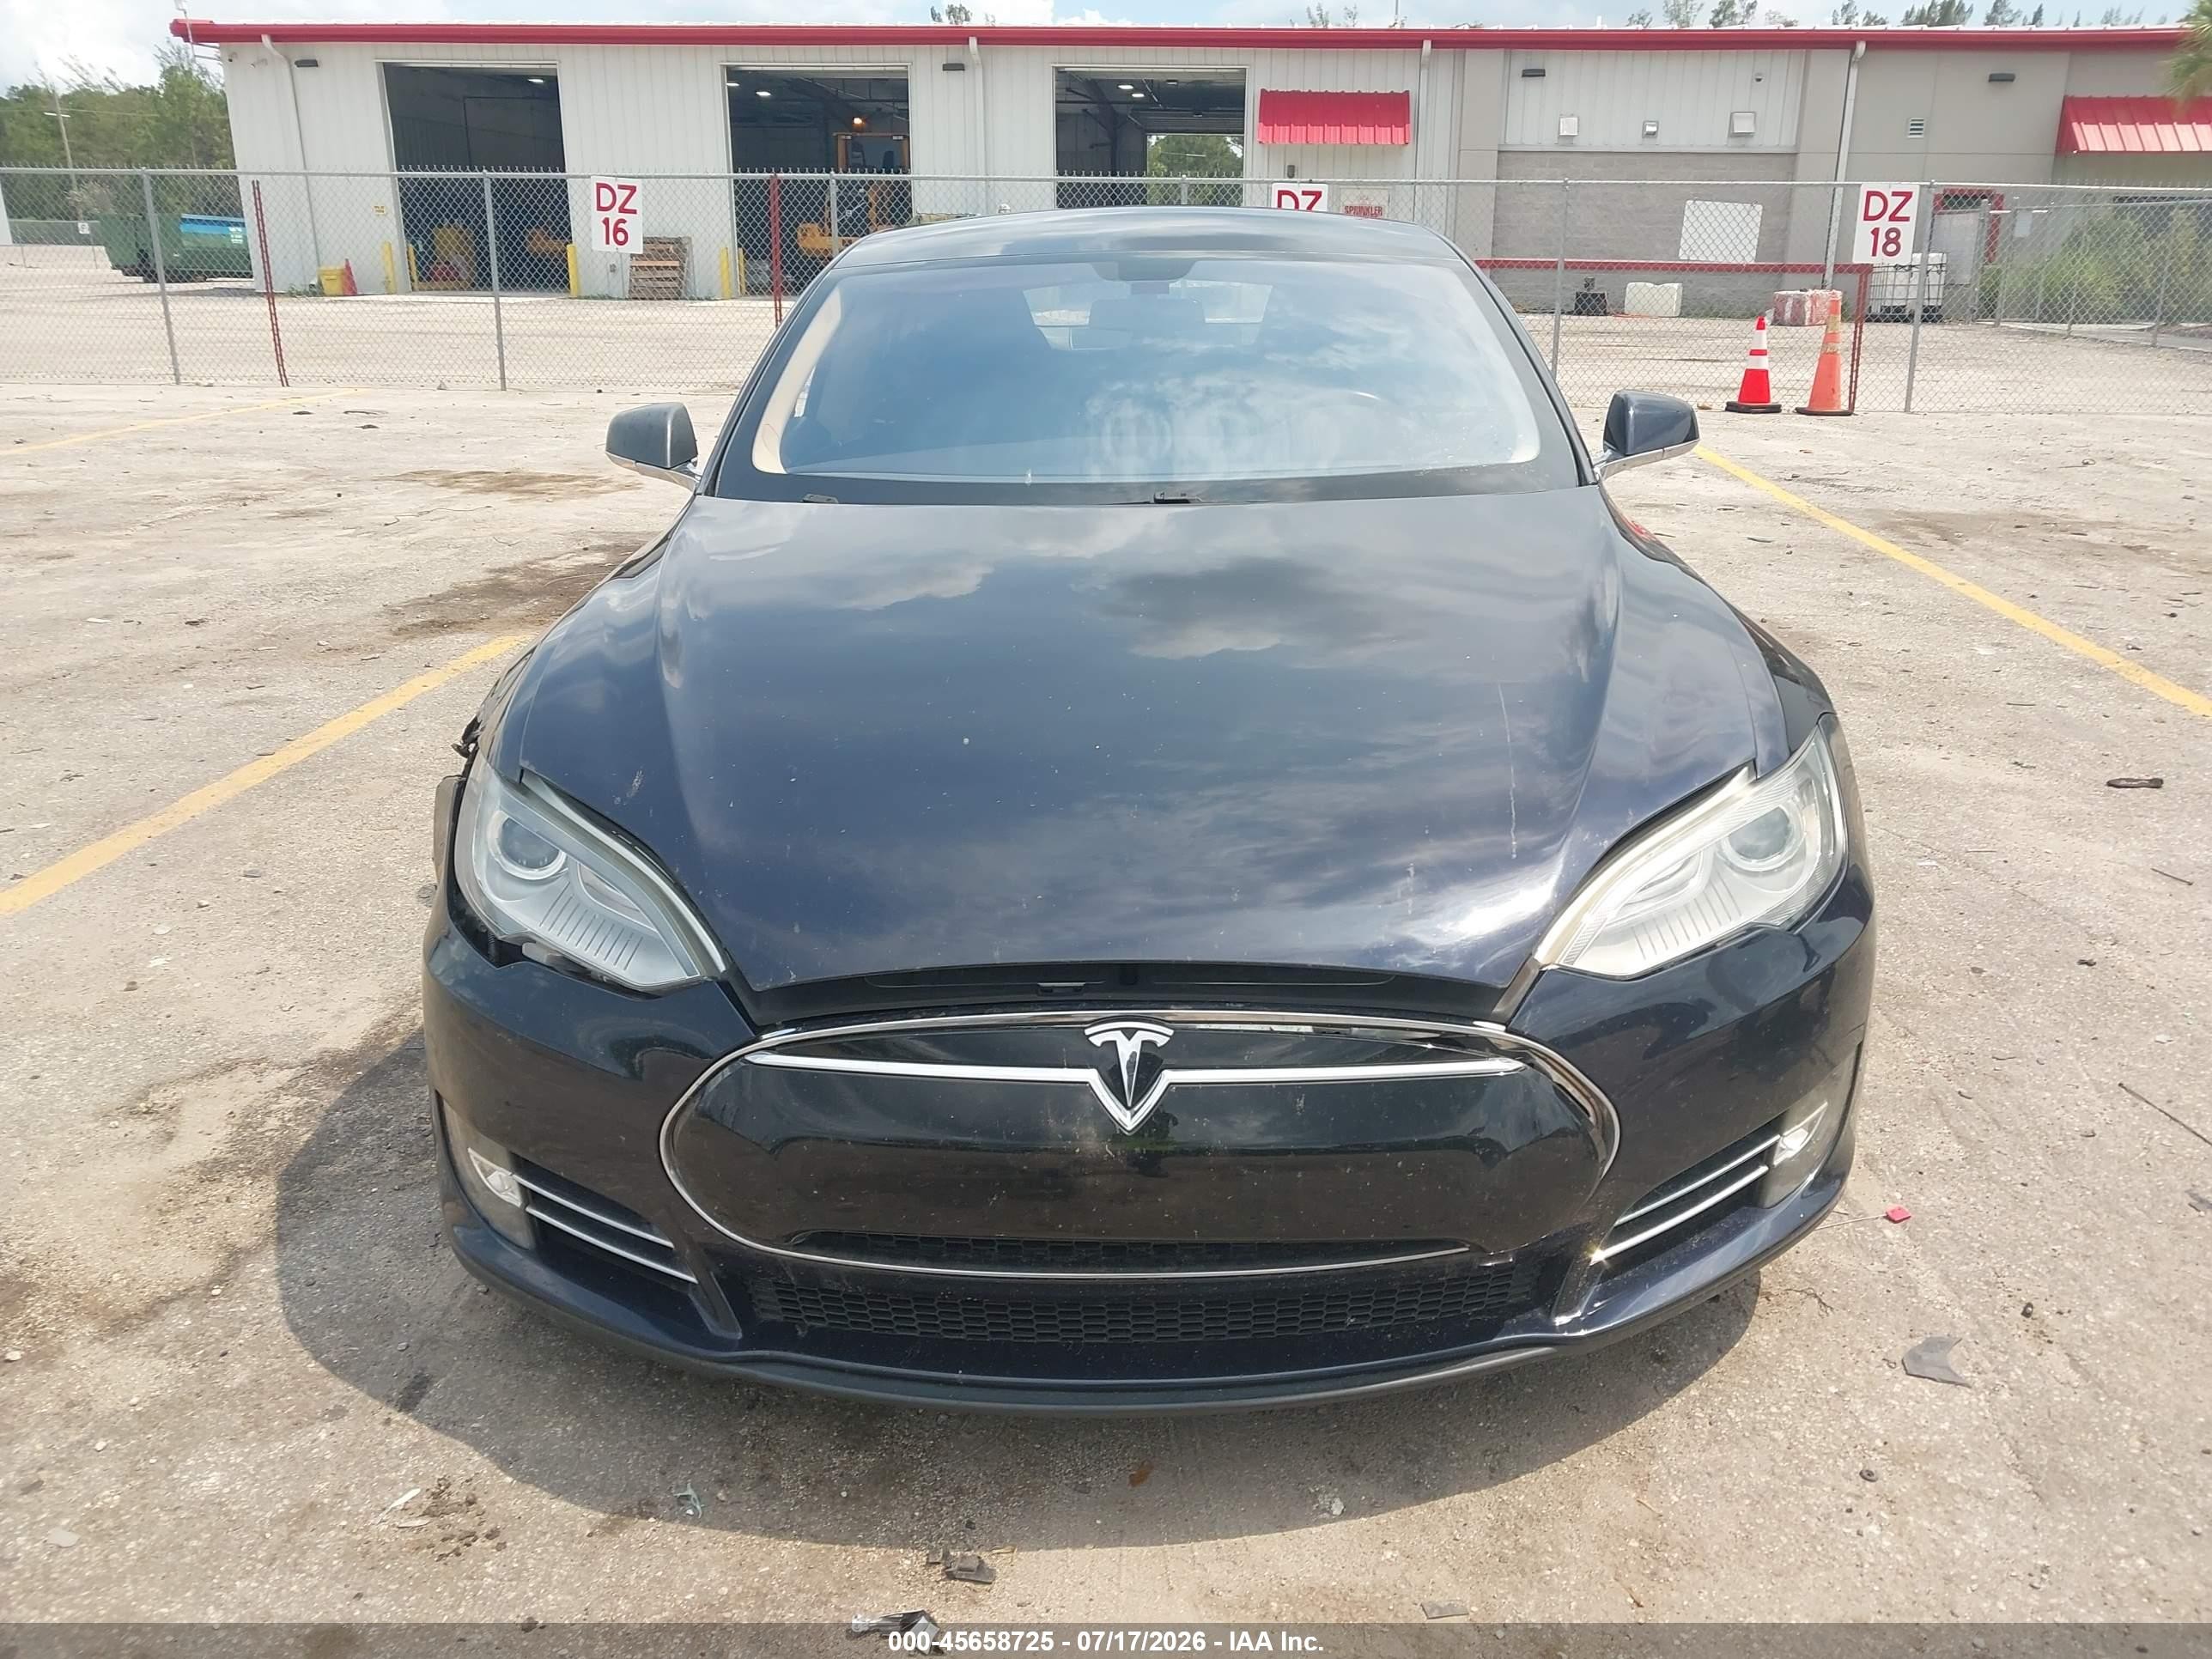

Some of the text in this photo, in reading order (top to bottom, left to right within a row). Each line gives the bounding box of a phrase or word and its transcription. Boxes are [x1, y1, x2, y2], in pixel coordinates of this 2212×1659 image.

[596, 182, 637, 215] DZ
[1277, 190, 1323, 211] DZ
[1344, 205, 1383, 217] SPRINKLER
[1863, 191, 1913, 222] DZ
[602, 217, 629, 246] 16
[1870, 227, 1901, 258] 18
